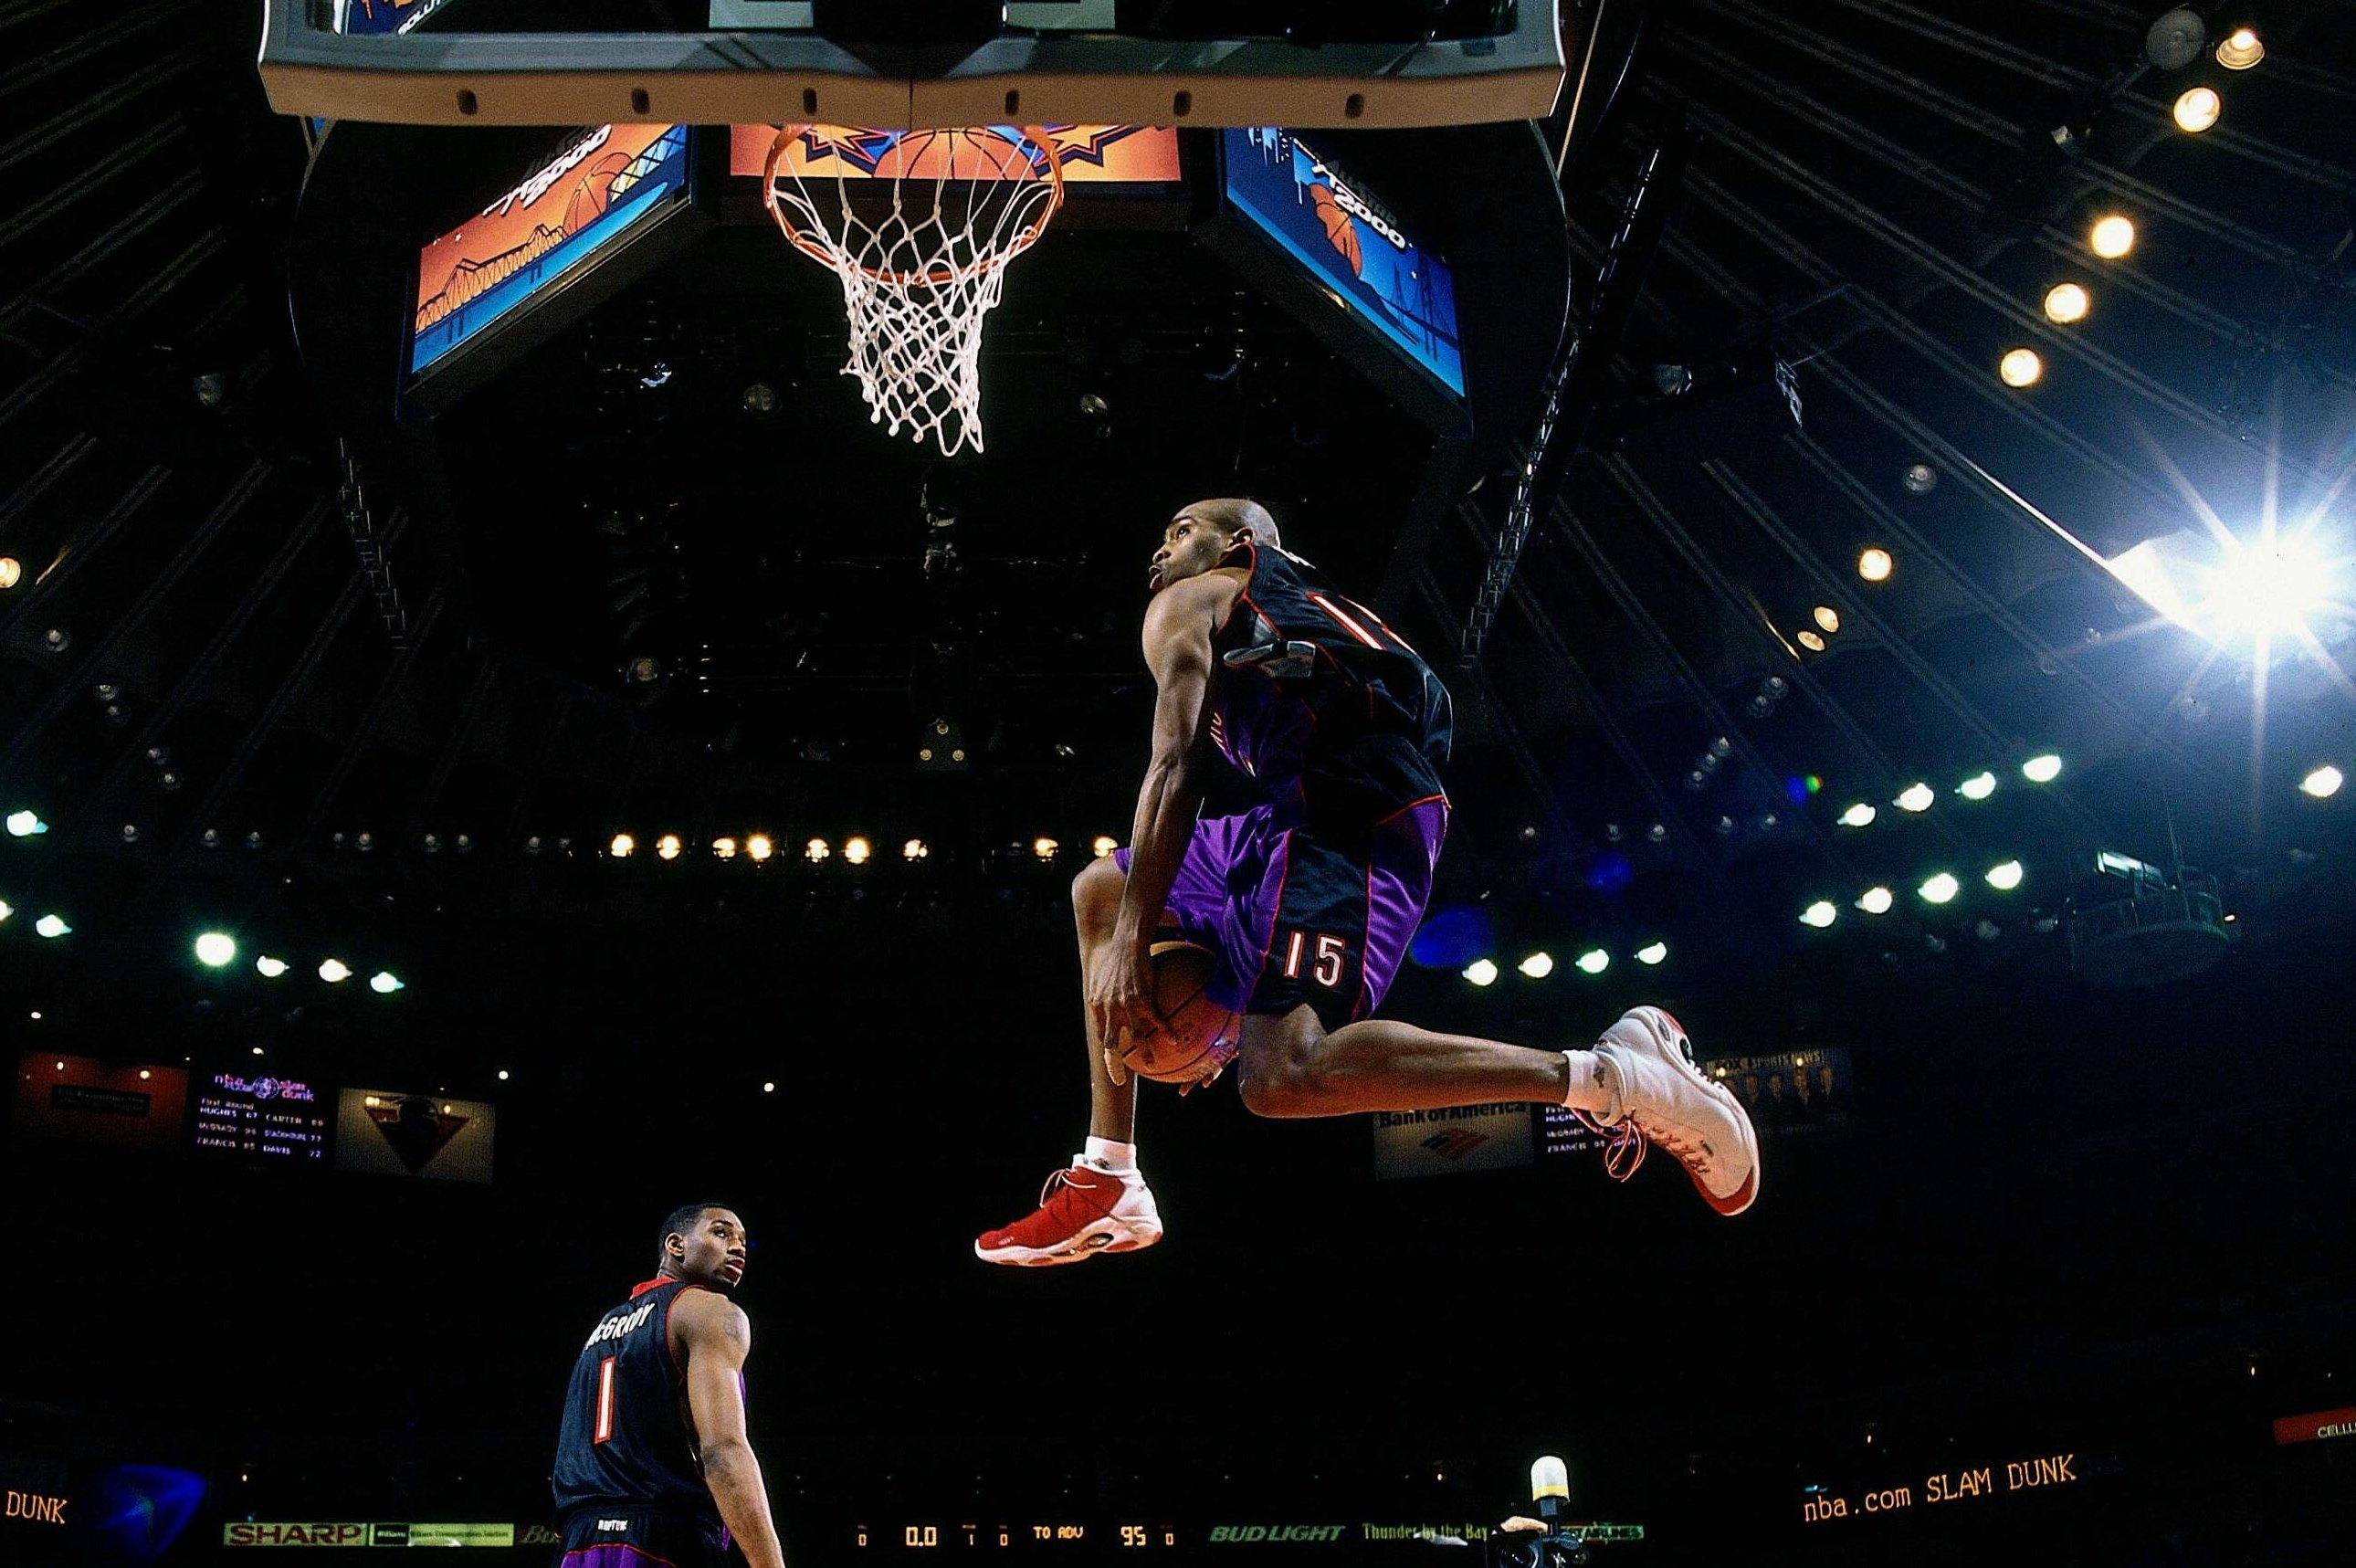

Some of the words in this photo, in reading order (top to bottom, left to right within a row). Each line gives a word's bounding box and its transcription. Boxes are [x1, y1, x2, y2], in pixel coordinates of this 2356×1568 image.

[1334, 185, 1406, 249] 2000
[1282, 930, 1346, 989] 15
[1380, 1110, 1425, 1128] Bank
[1450, 1103, 1526, 1120] America
[594, 1356, 616, 1445] 1
[1927, 1467, 1993, 1502] SLAM
[2007, 1453, 2077, 1491] DUNK
[5, 1490, 68, 1524] DUNK
[229, 1524, 363, 1545] SHARP
[905, 1526, 938, 1547] 0.0
[1032, 1526, 1051, 1540] TO
[1120, 1526, 1147, 1547] 95
[1207, 1524, 1267, 1542] BUD
[1267, 1524, 1347, 1542] LIGHT
[1362, 1521, 1418, 1542] Thunder
[1422, 1522, 1436, 1542] by
[1440, 1521, 1462, 1541] the
[1466, 1521, 1489, 1542] Bay
